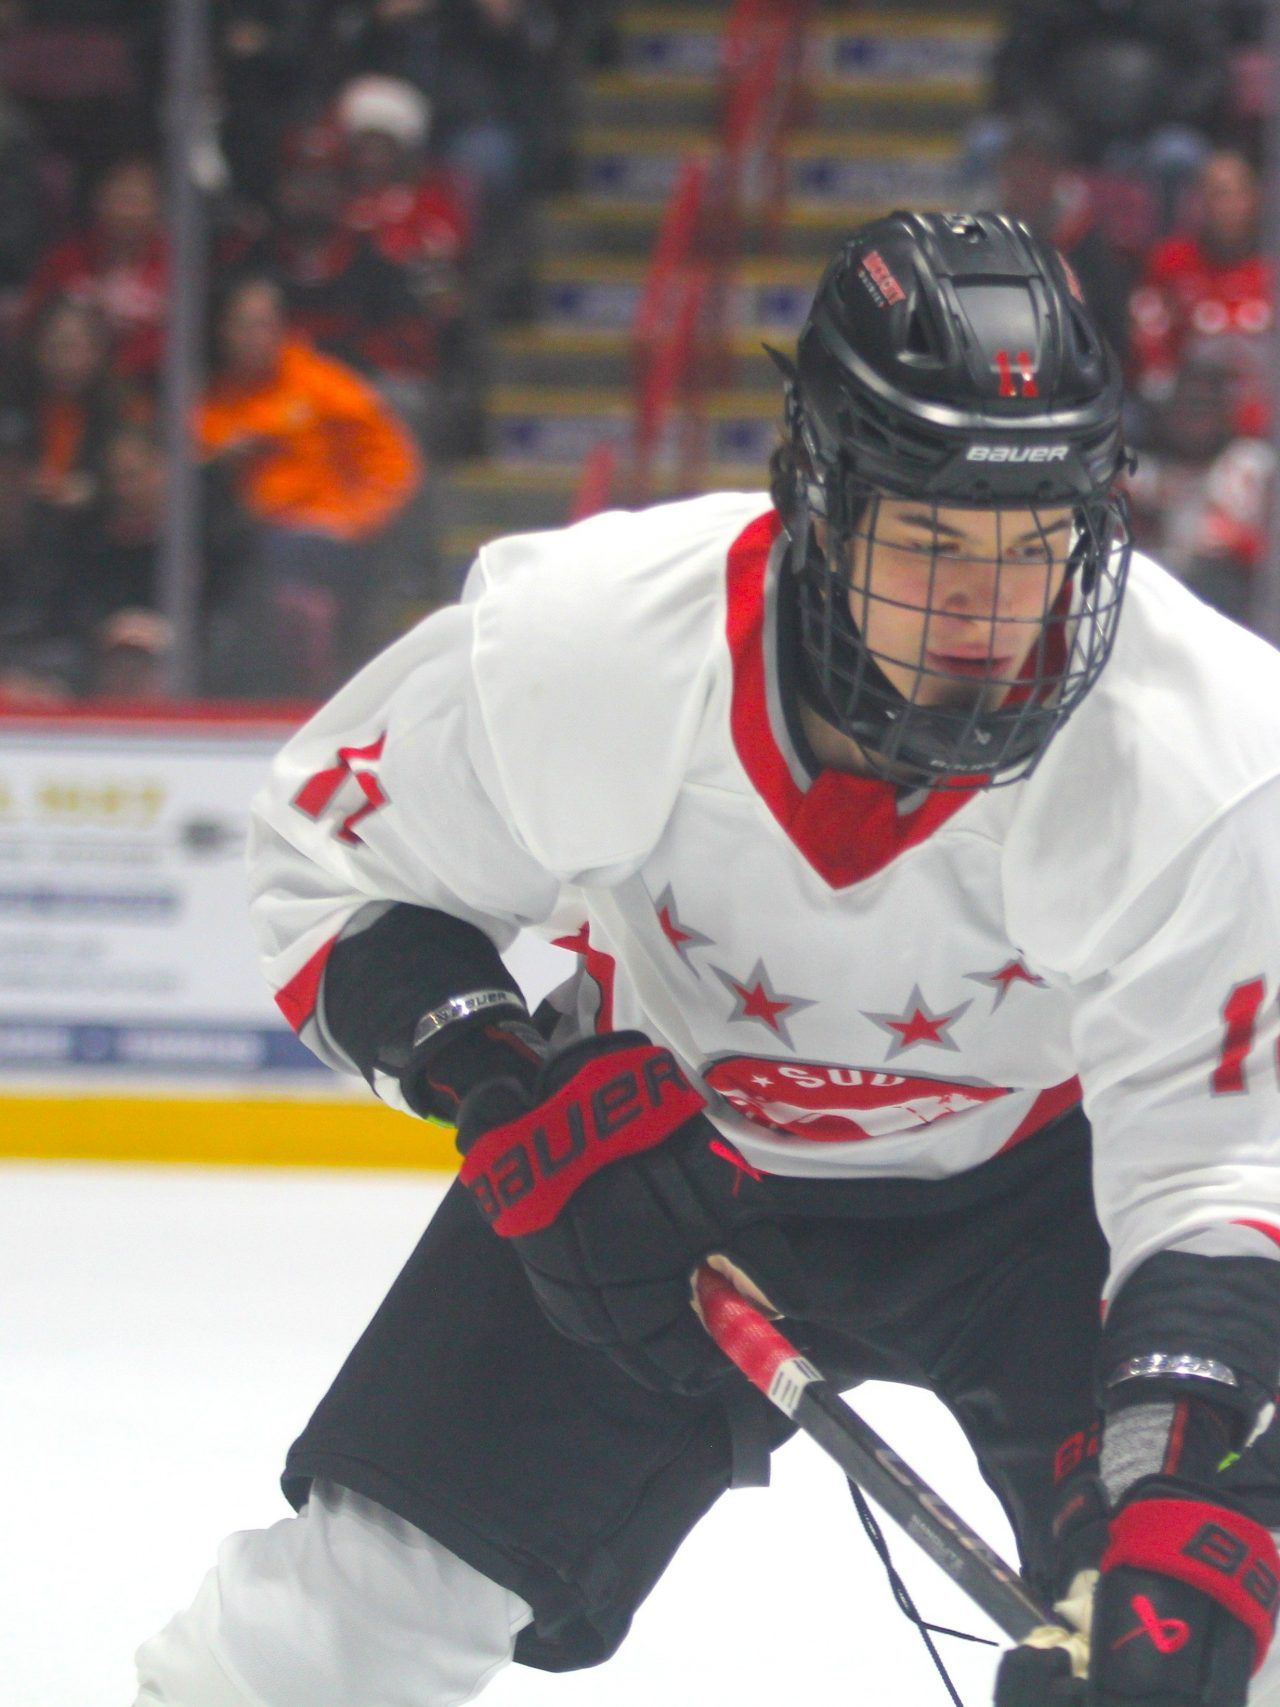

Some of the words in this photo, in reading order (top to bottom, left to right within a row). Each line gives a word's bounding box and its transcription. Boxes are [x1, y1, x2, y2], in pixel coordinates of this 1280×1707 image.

[994, 348, 1040, 397] 11
[966, 445, 1069, 463] BAUER
[472, 1049, 690, 1222] BAUER
